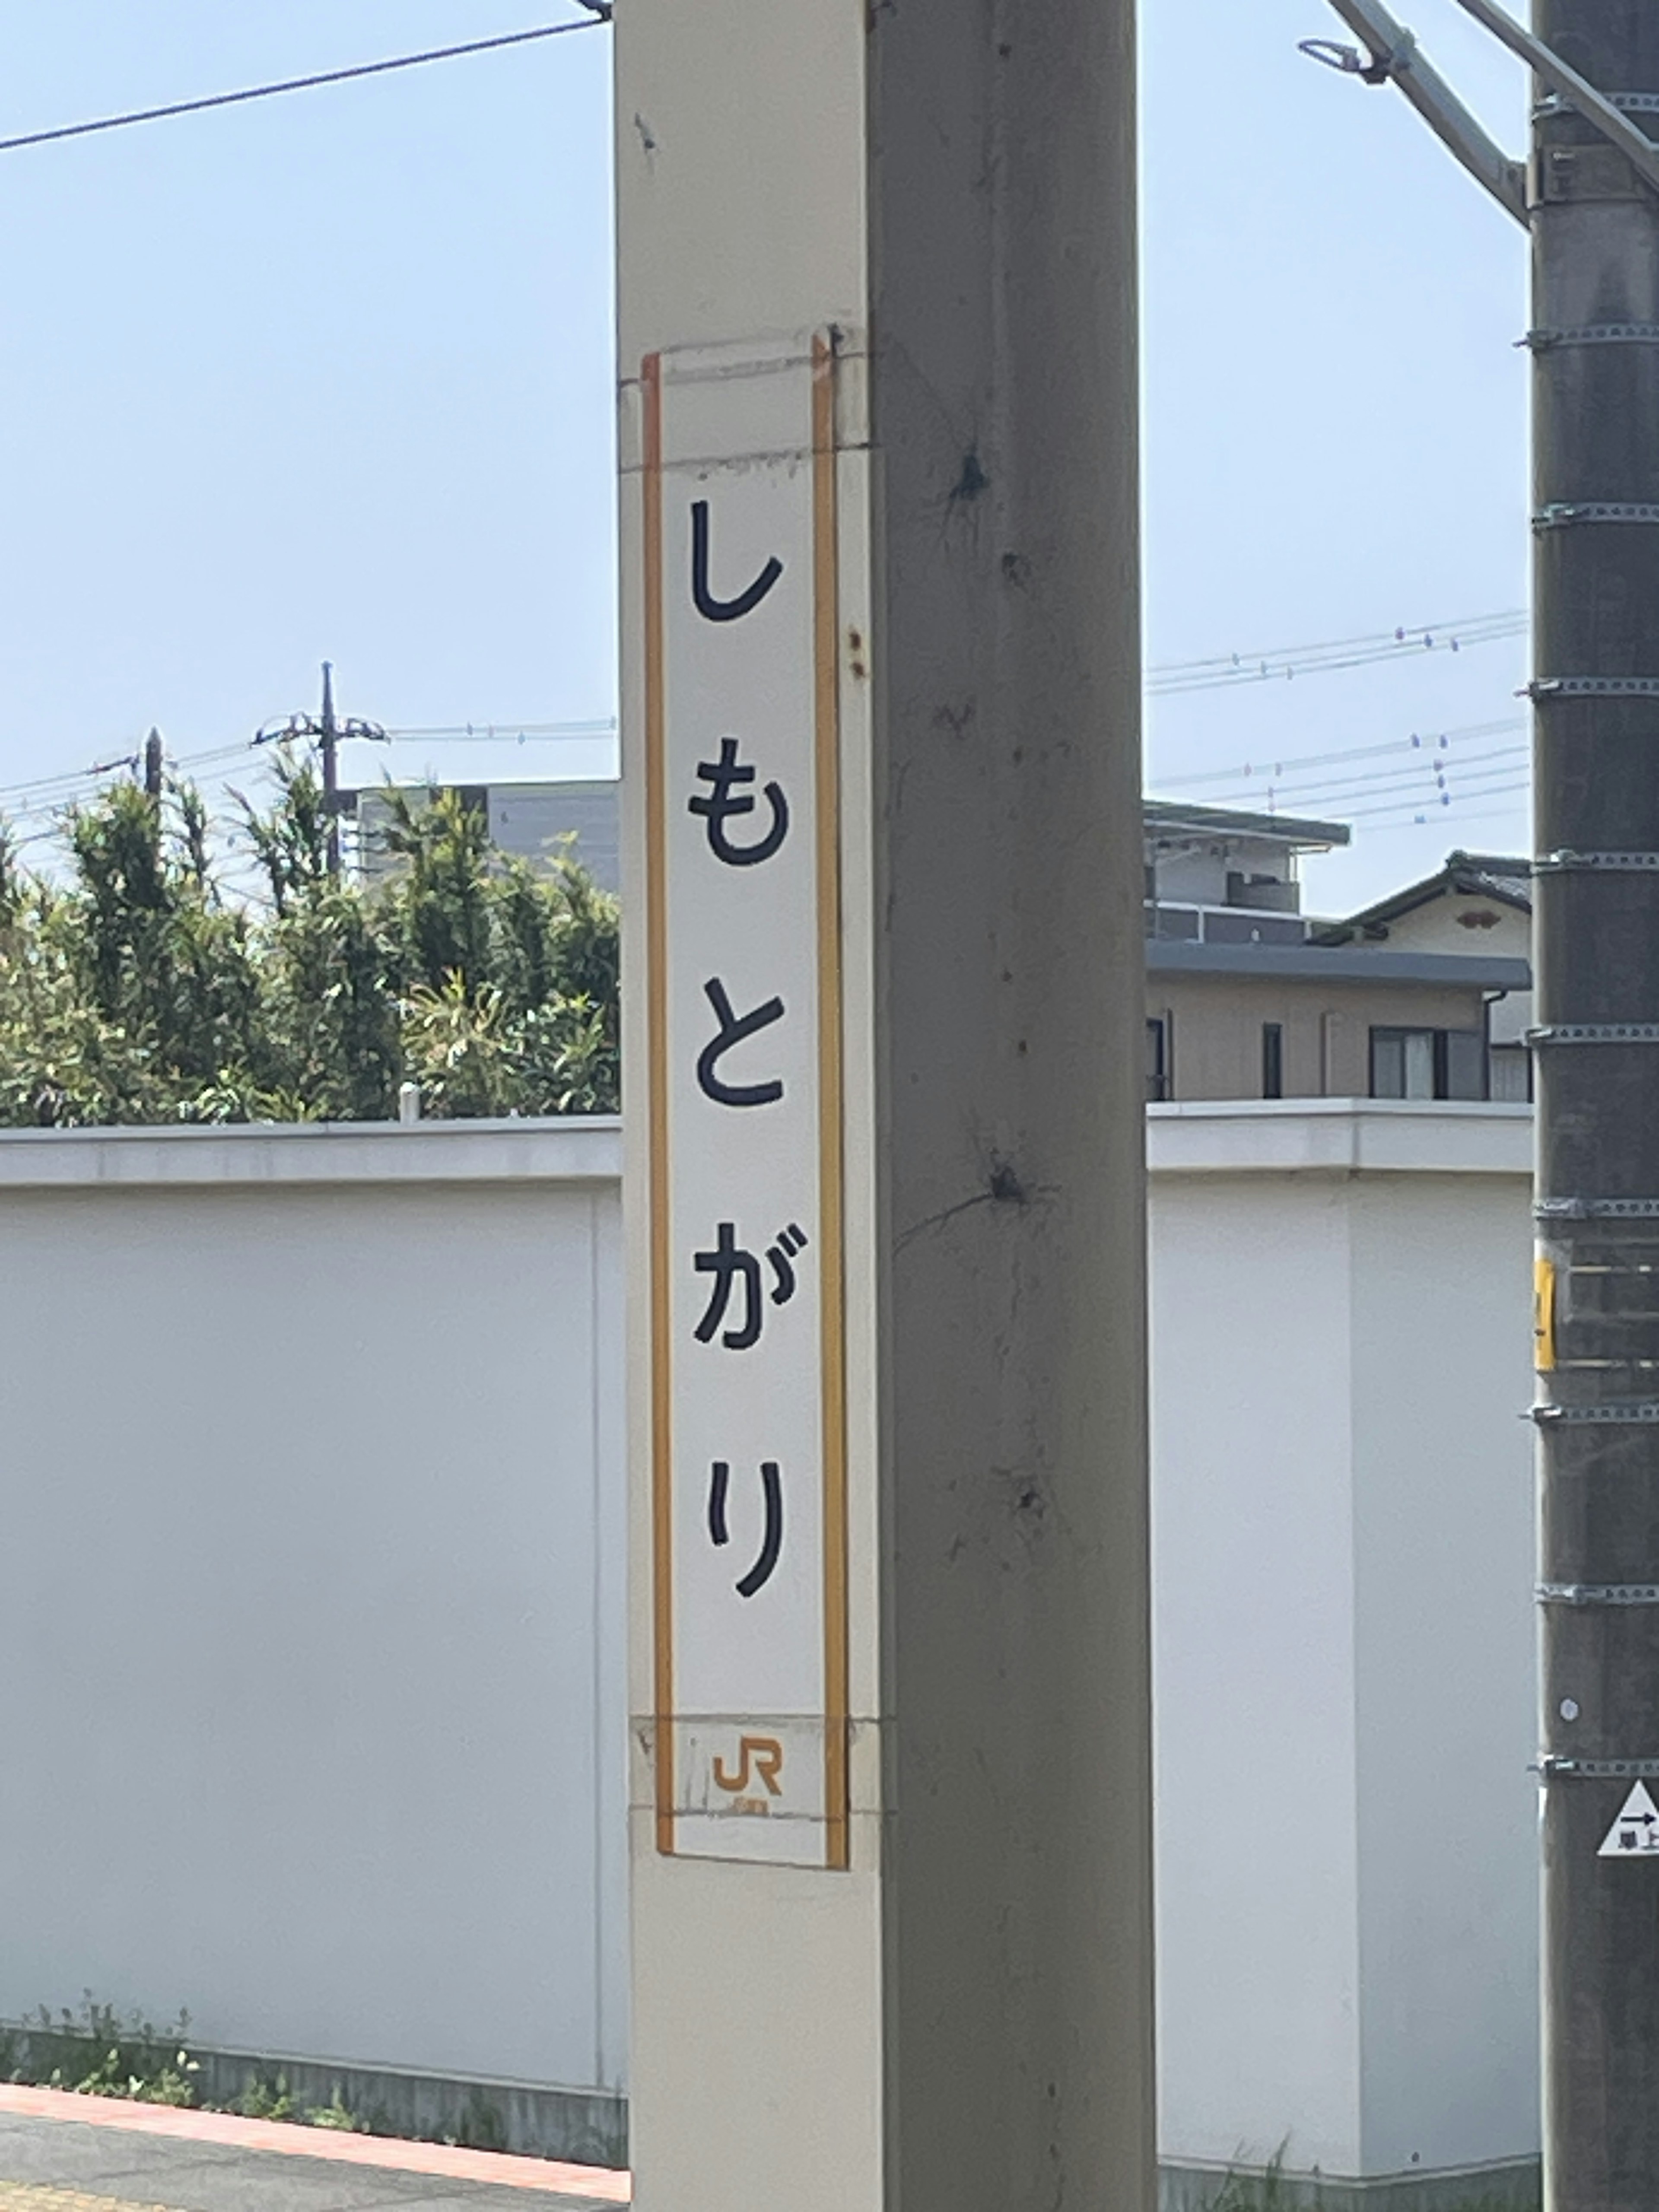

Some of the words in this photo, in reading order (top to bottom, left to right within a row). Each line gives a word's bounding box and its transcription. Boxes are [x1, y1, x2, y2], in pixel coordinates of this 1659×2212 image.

[688, 500, 807, 1598] しもとがり
[713, 1736, 782, 1796] JR
